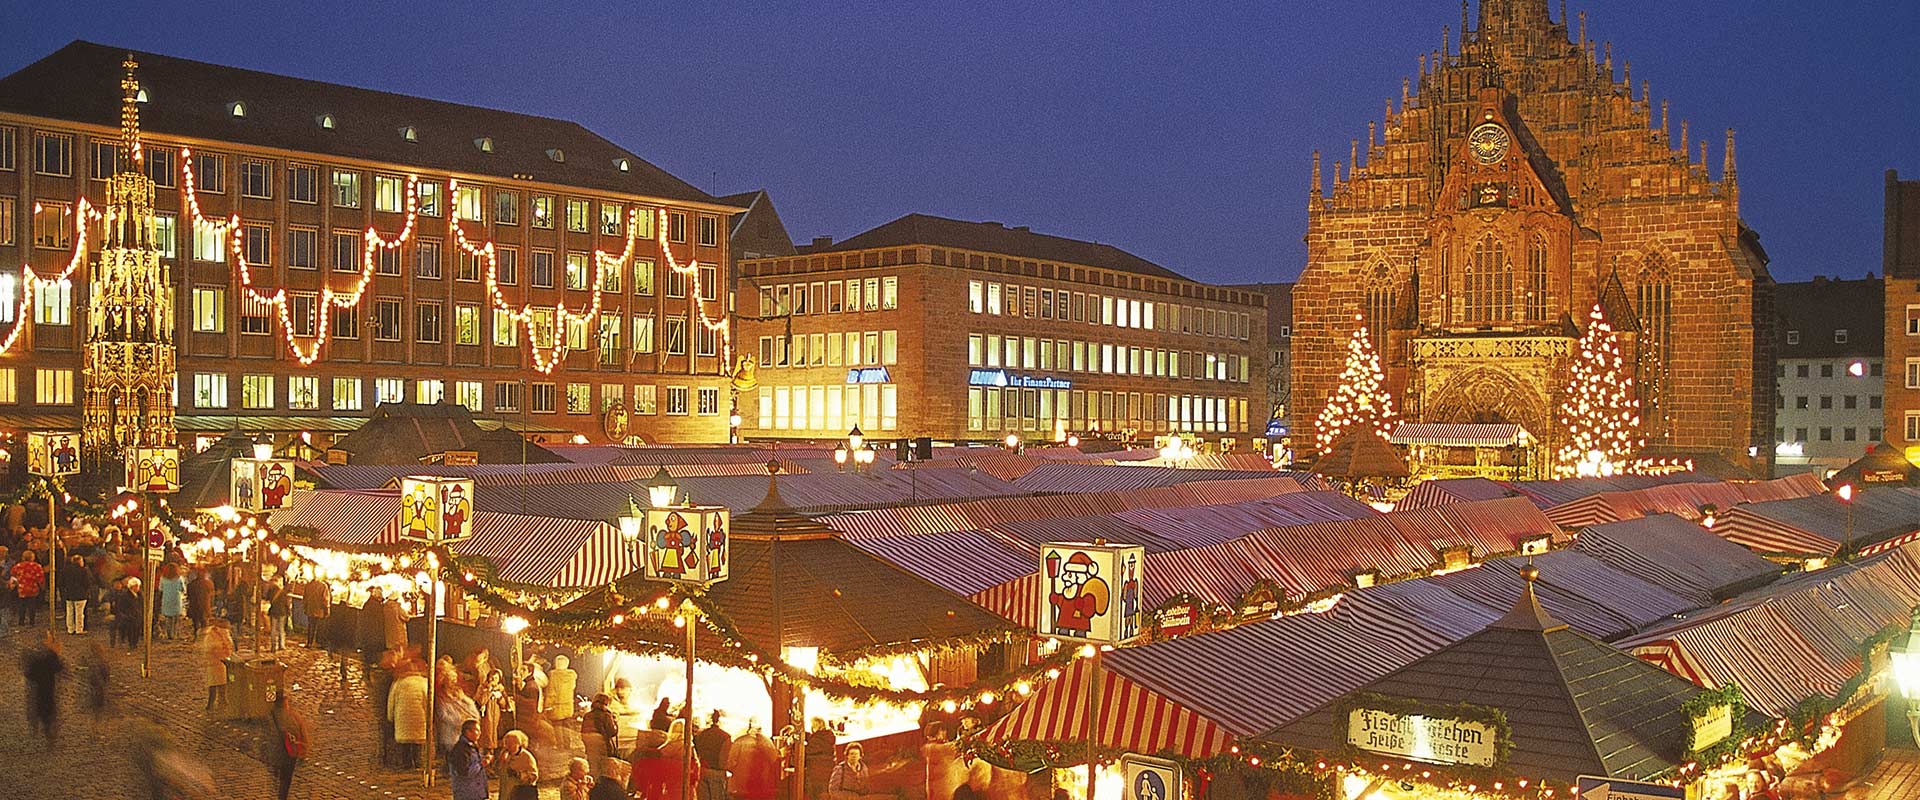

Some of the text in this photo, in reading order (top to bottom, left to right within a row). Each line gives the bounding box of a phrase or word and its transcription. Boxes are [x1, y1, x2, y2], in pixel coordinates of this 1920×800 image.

[1010, 375, 1022, 386] Ihr
[1023, 376, 1071, 389] FinanzPartner
[1366, 731, 1404, 750] Heiße
